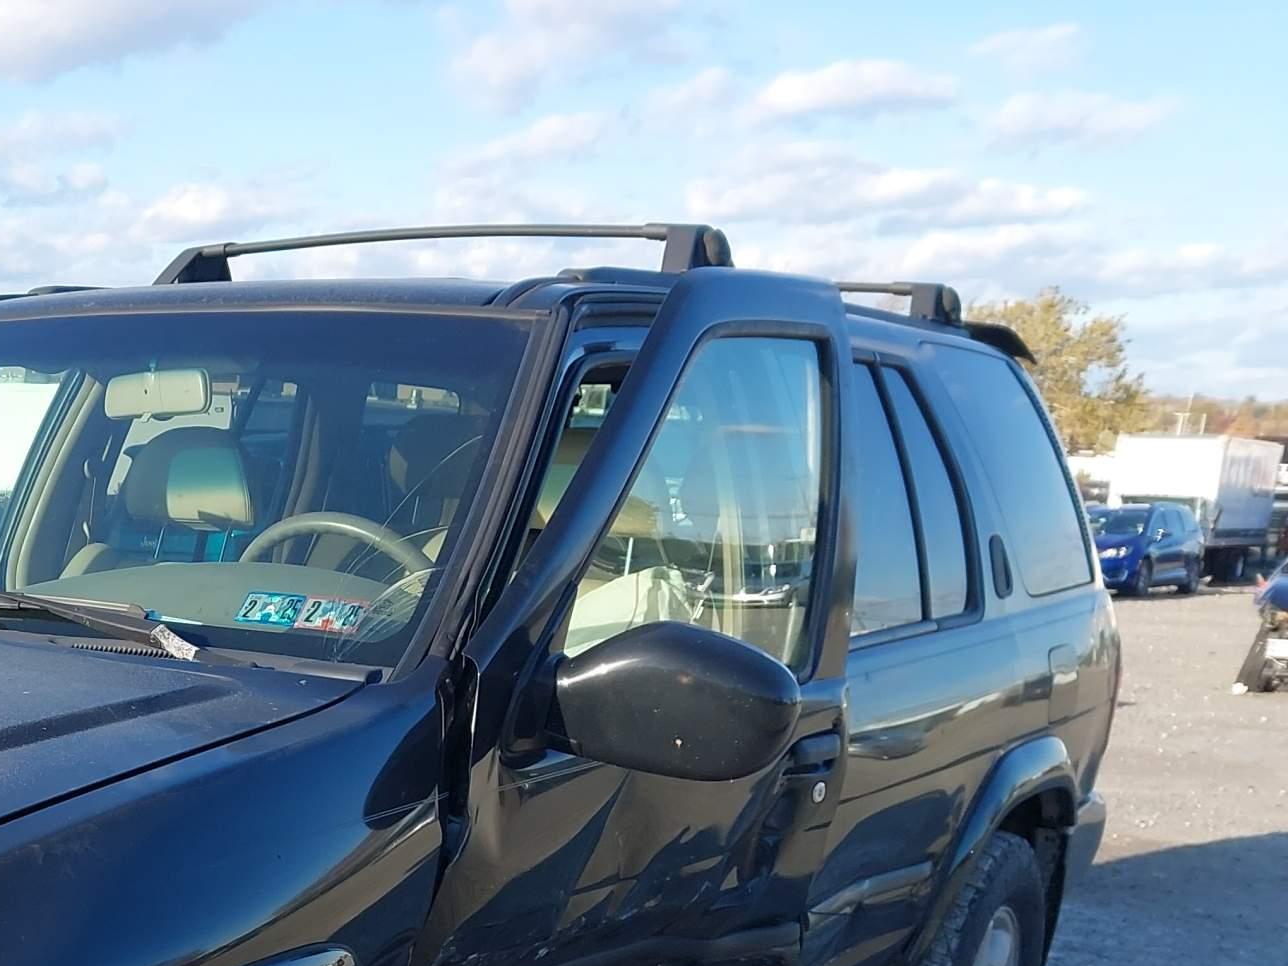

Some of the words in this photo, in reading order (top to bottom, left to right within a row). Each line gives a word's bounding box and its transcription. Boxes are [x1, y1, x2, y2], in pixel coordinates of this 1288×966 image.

[243, 599, 257, 618] 2
[281, 598, 303, 620] 25
[304, 600, 321, 623] 2
